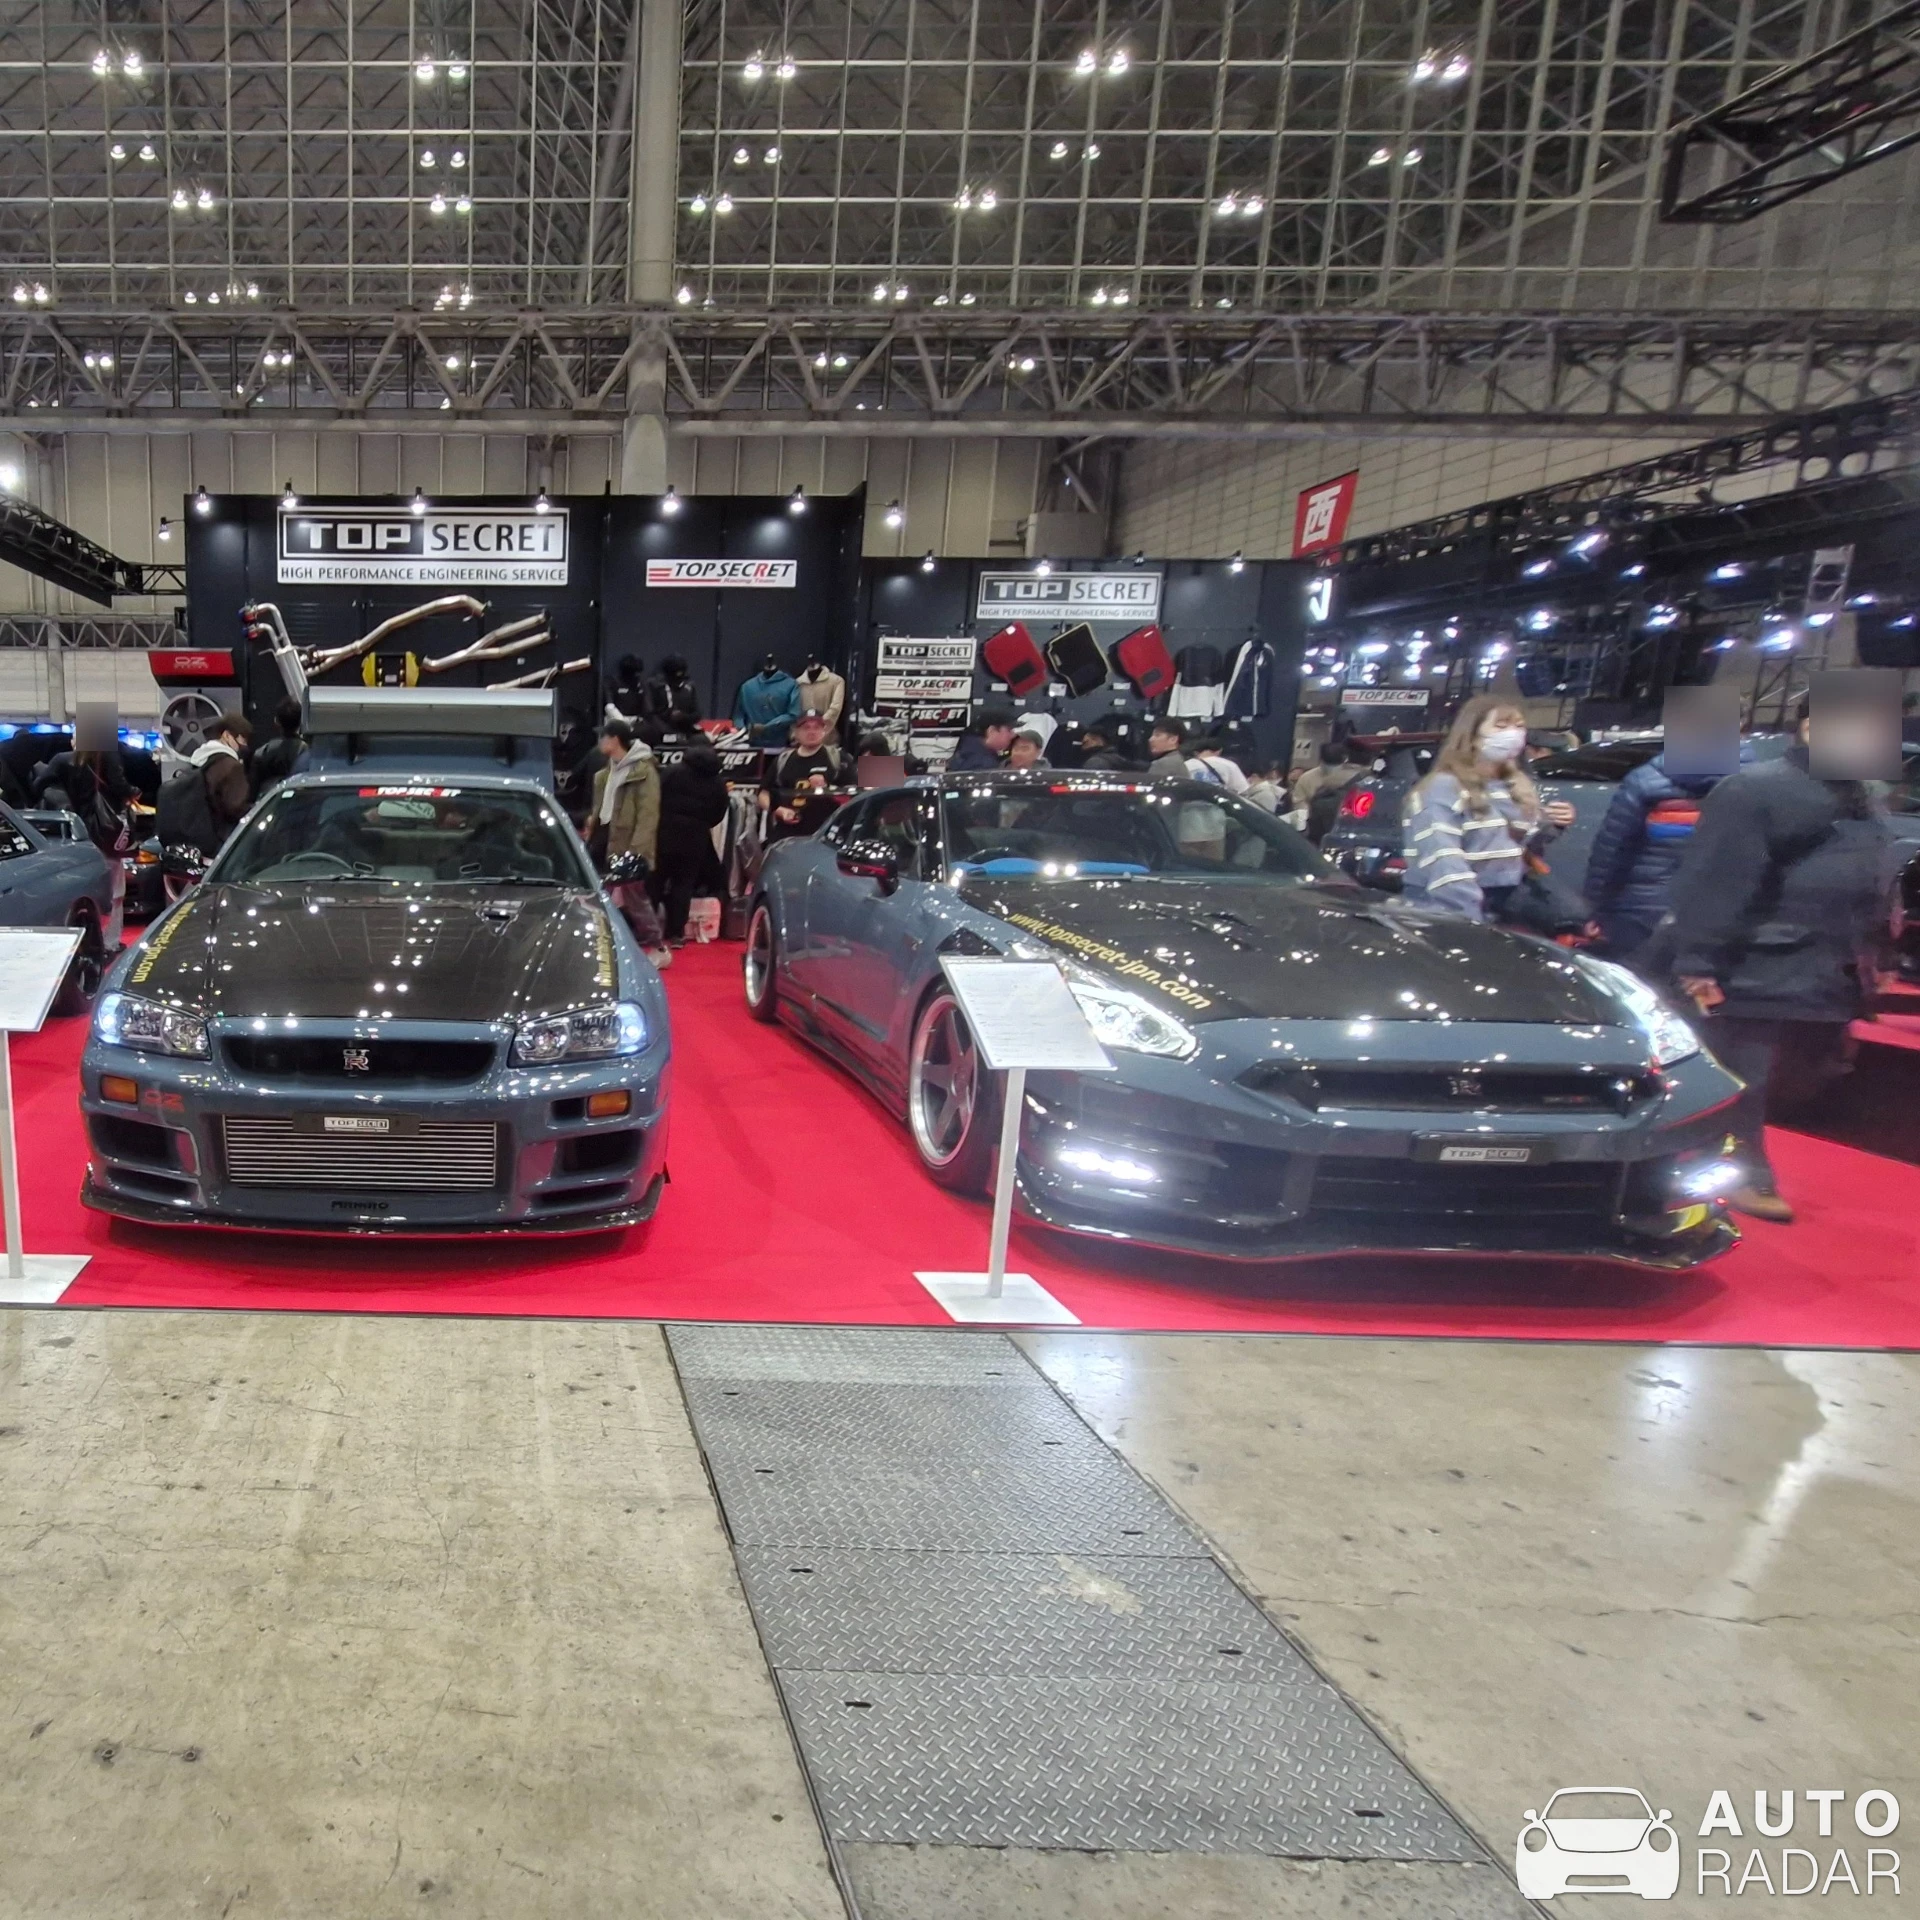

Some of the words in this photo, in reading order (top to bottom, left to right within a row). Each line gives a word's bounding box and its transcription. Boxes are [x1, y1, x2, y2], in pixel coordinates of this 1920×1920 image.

[1302, 484, 1342, 548] 西
[300, 522, 411, 550] TOP
[430, 523, 555, 551] SECRET
[281, 566, 313, 579] HIGH
[318, 567, 414, 580] PERFORMANCE
[419, 568, 508, 581] ENGINEERING
[511, 569, 566, 581] SERVICE
[675, 562, 716, 577] TOP
[716, 562, 795, 577] SECRET
[993, 581, 1063, 598] TOP
[1073, 581, 1152, 600] SECRET
[979, 608, 1000, 616] HIGH
[1002, 608, 1061, 616] PERFORMANCE
[1064, 609, 1119, 617] ENGINEERING
[889, 646, 926, 656] TOP
[929, 646, 969, 656] SECRET
[897, 679, 921, 688] TOP
[921, 679, 968, 689] SECRET
[661, 751, 684, 764] TO
[1009, 913, 1212, 1010] www.topsecret-jpn.com
